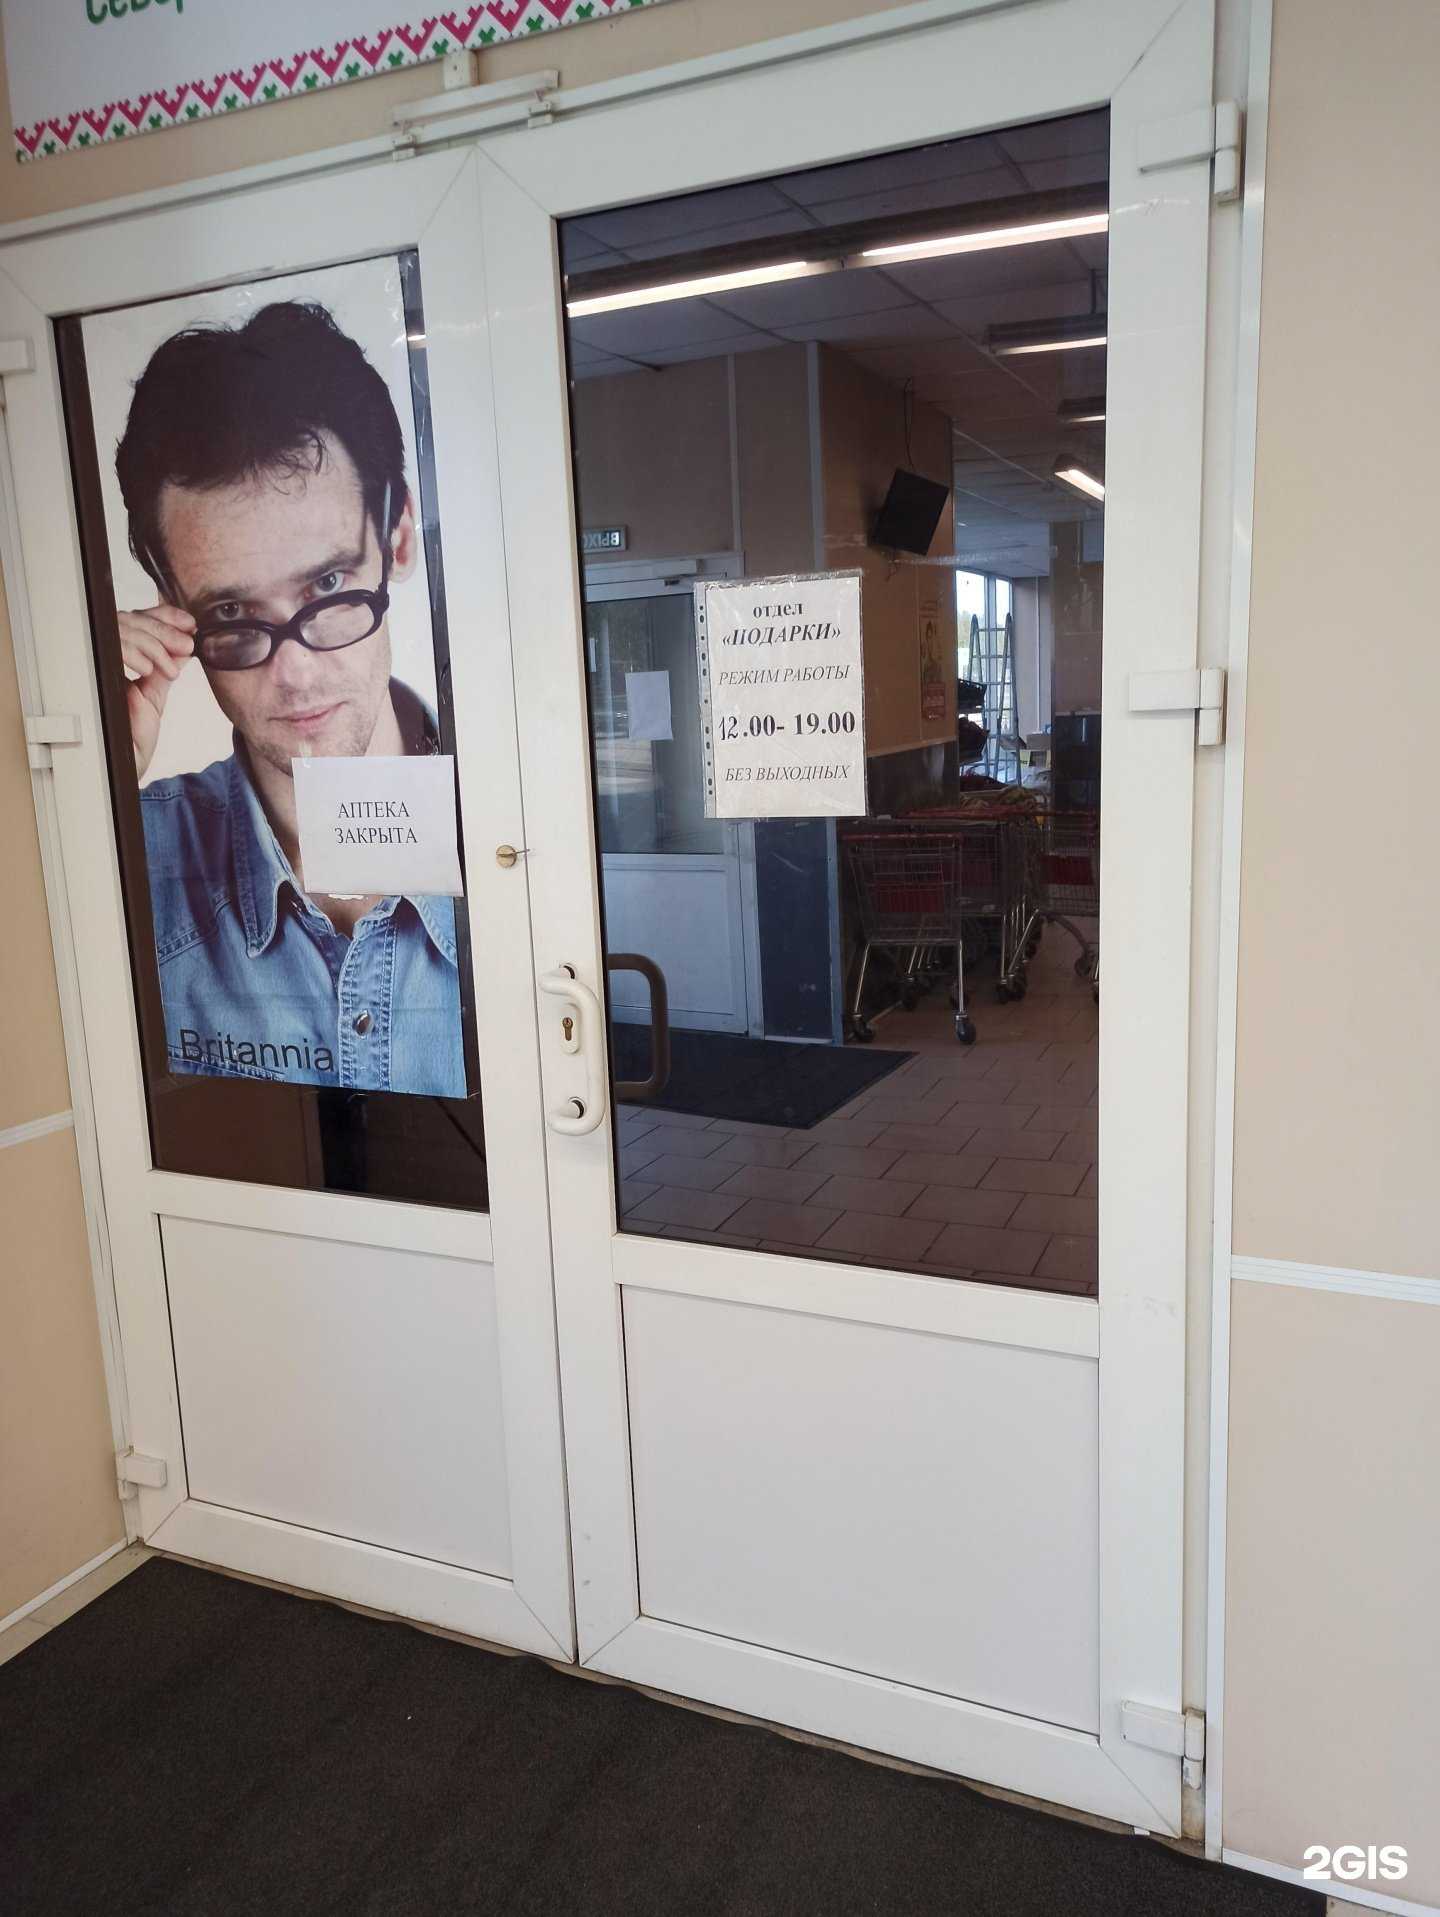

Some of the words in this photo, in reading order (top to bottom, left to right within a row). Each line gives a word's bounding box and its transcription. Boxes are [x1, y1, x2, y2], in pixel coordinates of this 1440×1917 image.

[752, 602, 803, 618] отдел
[722, 622, 841, 646] «ПОДАРКИ»
[719, 669, 779, 685] РЕЖИМ
[783, 665, 850, 682] РАБОТЫ
[794, 711, 856, 736] 19.00
[725, 767, 752, 782] БЕЗ
[756, 765, 850, 781] ВЫХОДНЫХ
[338, 801, 410, 818] АПТЕКА
[334, 827, 418, 844] ЗАКРЫТА
[180, 1029, 334, 1072] Britannia
